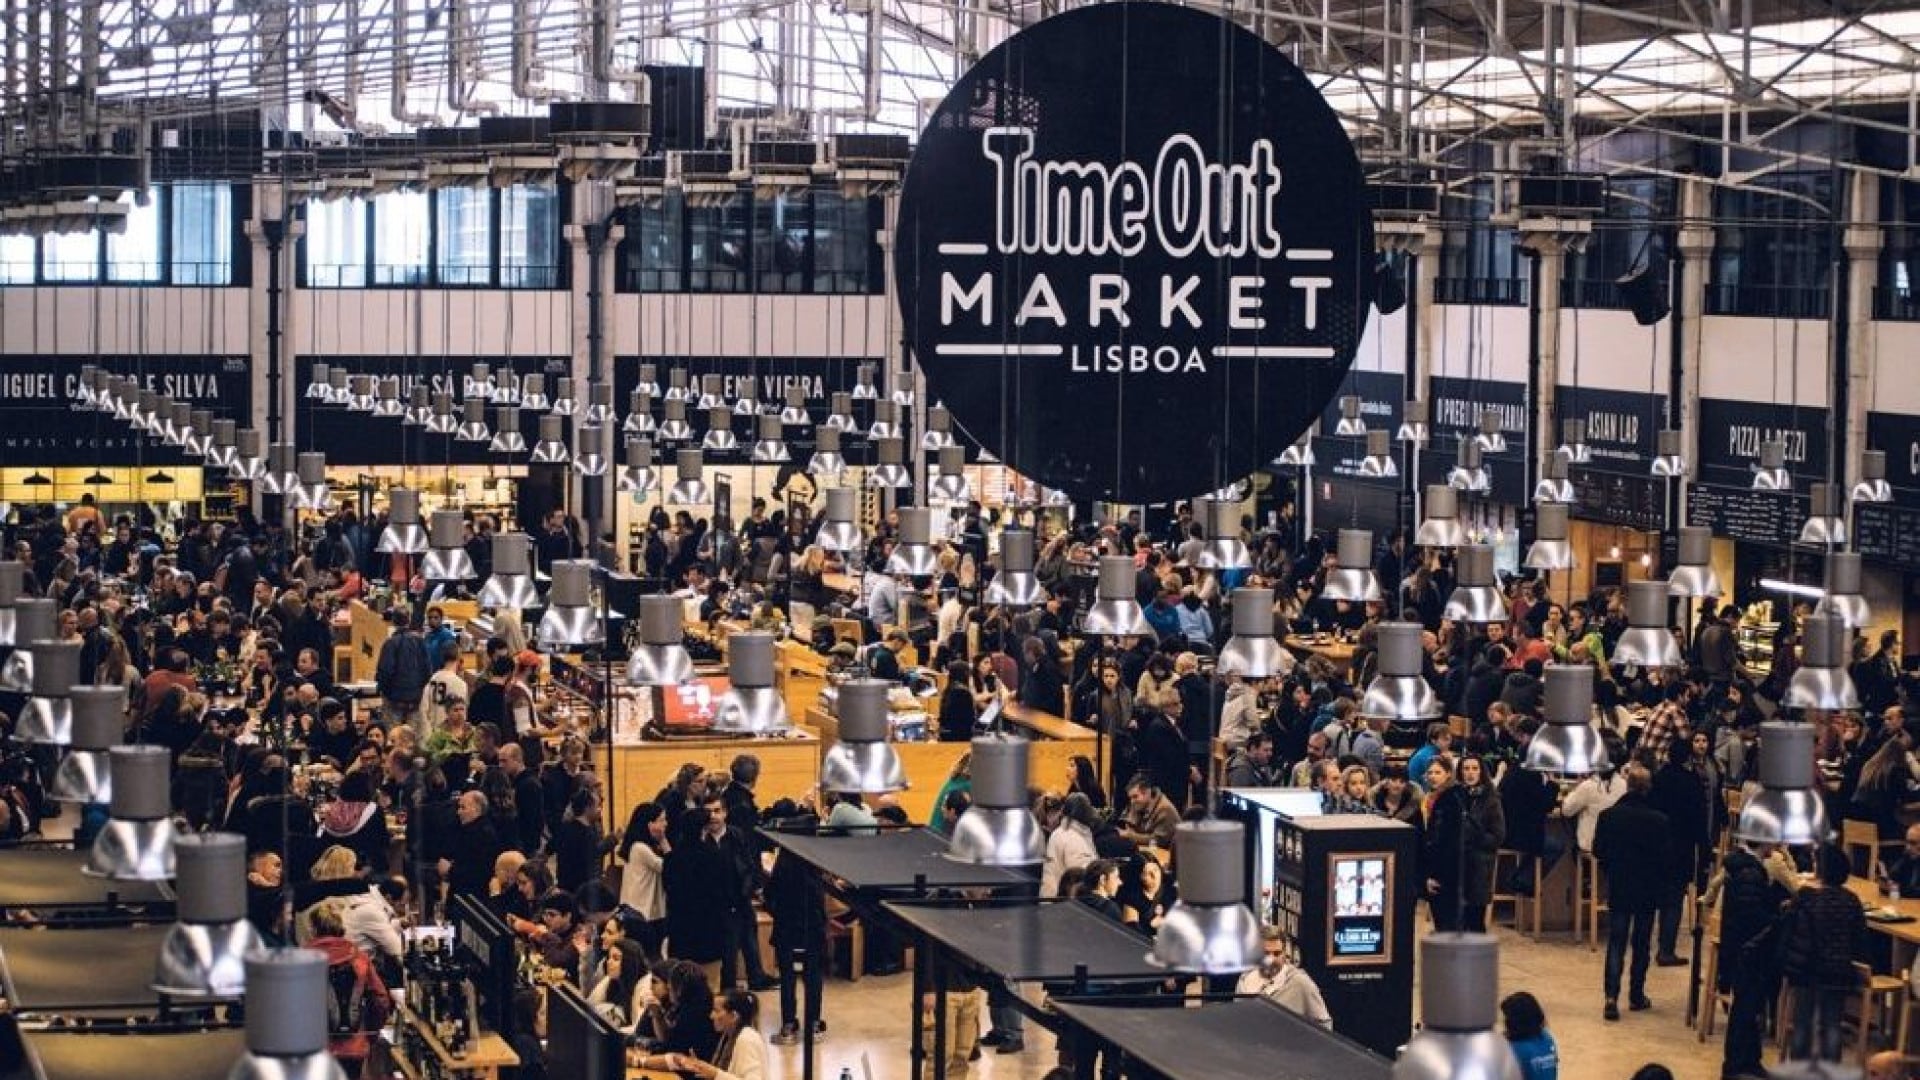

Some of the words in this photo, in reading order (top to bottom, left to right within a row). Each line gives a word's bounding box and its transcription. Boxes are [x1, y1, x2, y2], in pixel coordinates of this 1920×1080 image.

[940, 271, 1334, 329] MARKET
[1071, 346, 1206, 373] LISBOA
[0, 373, 56, 398] IGUEL
[164, 373, 218, 399] SILVA
[1587, 410, 1617, 440] ASIAN
[1619, 413, 1639, 445] LAB
[1729, 425, 1760, 458] PIZZA
